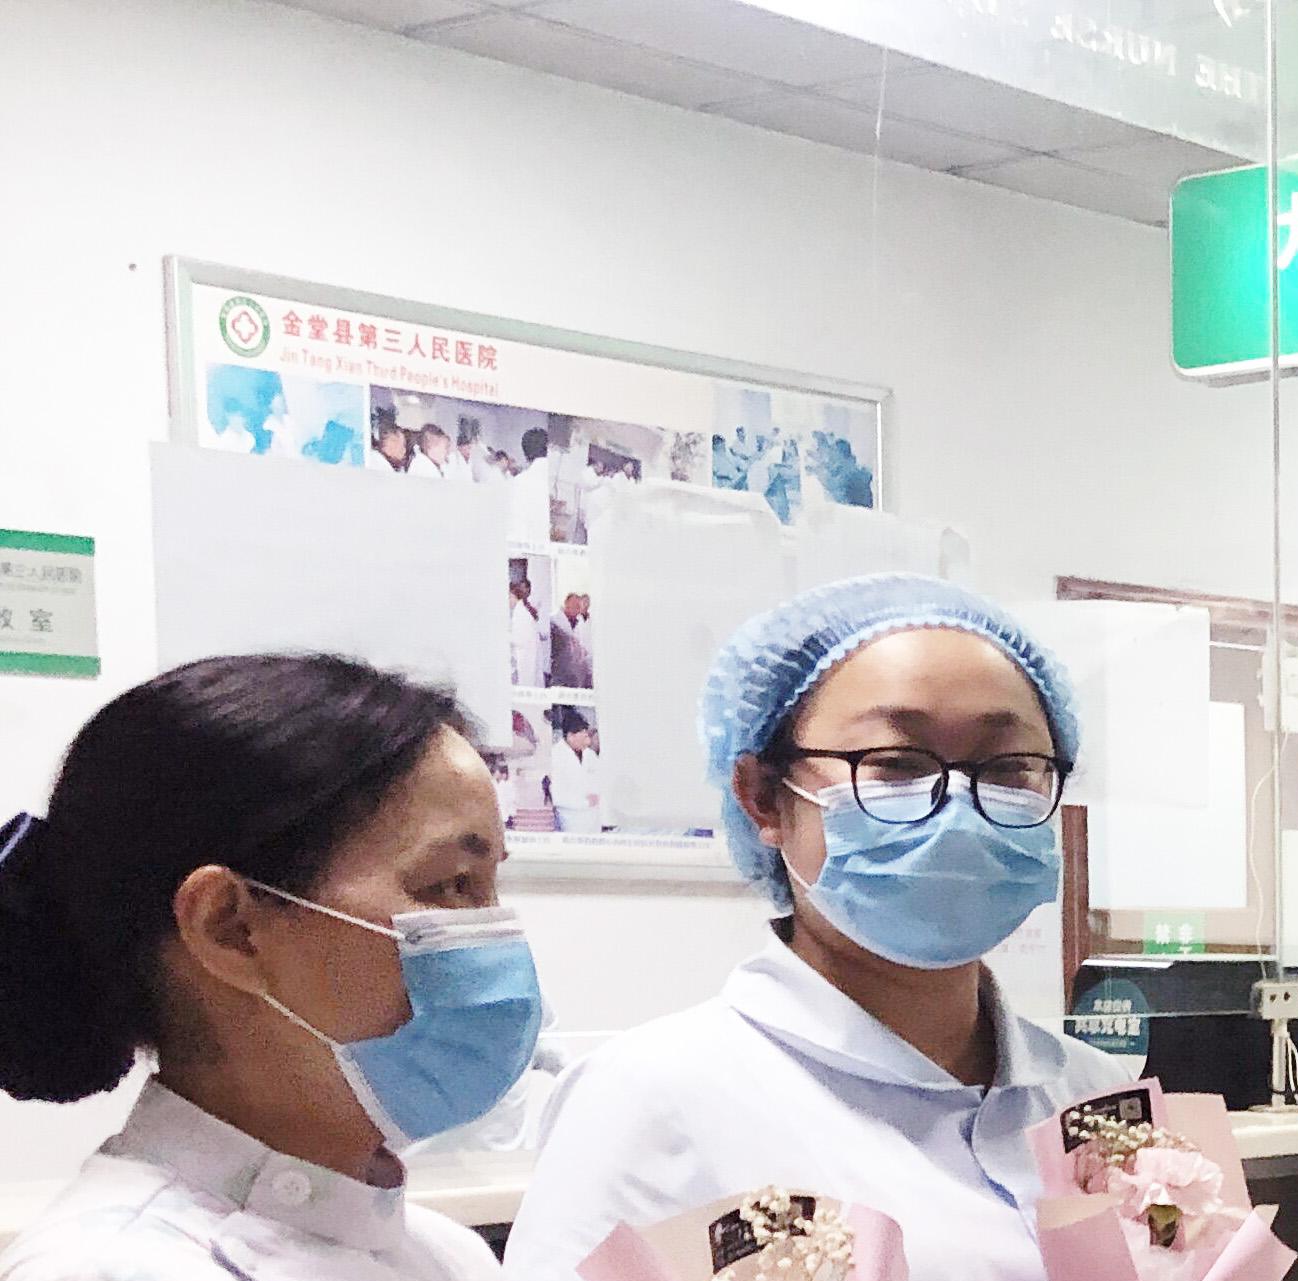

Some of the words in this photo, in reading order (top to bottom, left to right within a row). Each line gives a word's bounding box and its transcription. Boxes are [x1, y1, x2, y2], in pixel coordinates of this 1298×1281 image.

[282, 310, 499, 371] 金堂县第三人民医院
[302, 349, 332, 373] Tang
[336, 355, 363, 374] Xian
[366, 360, 400, 380] Third
[401, 365, 449, 389] People's
[451, 376, 499, 398] Hospital
